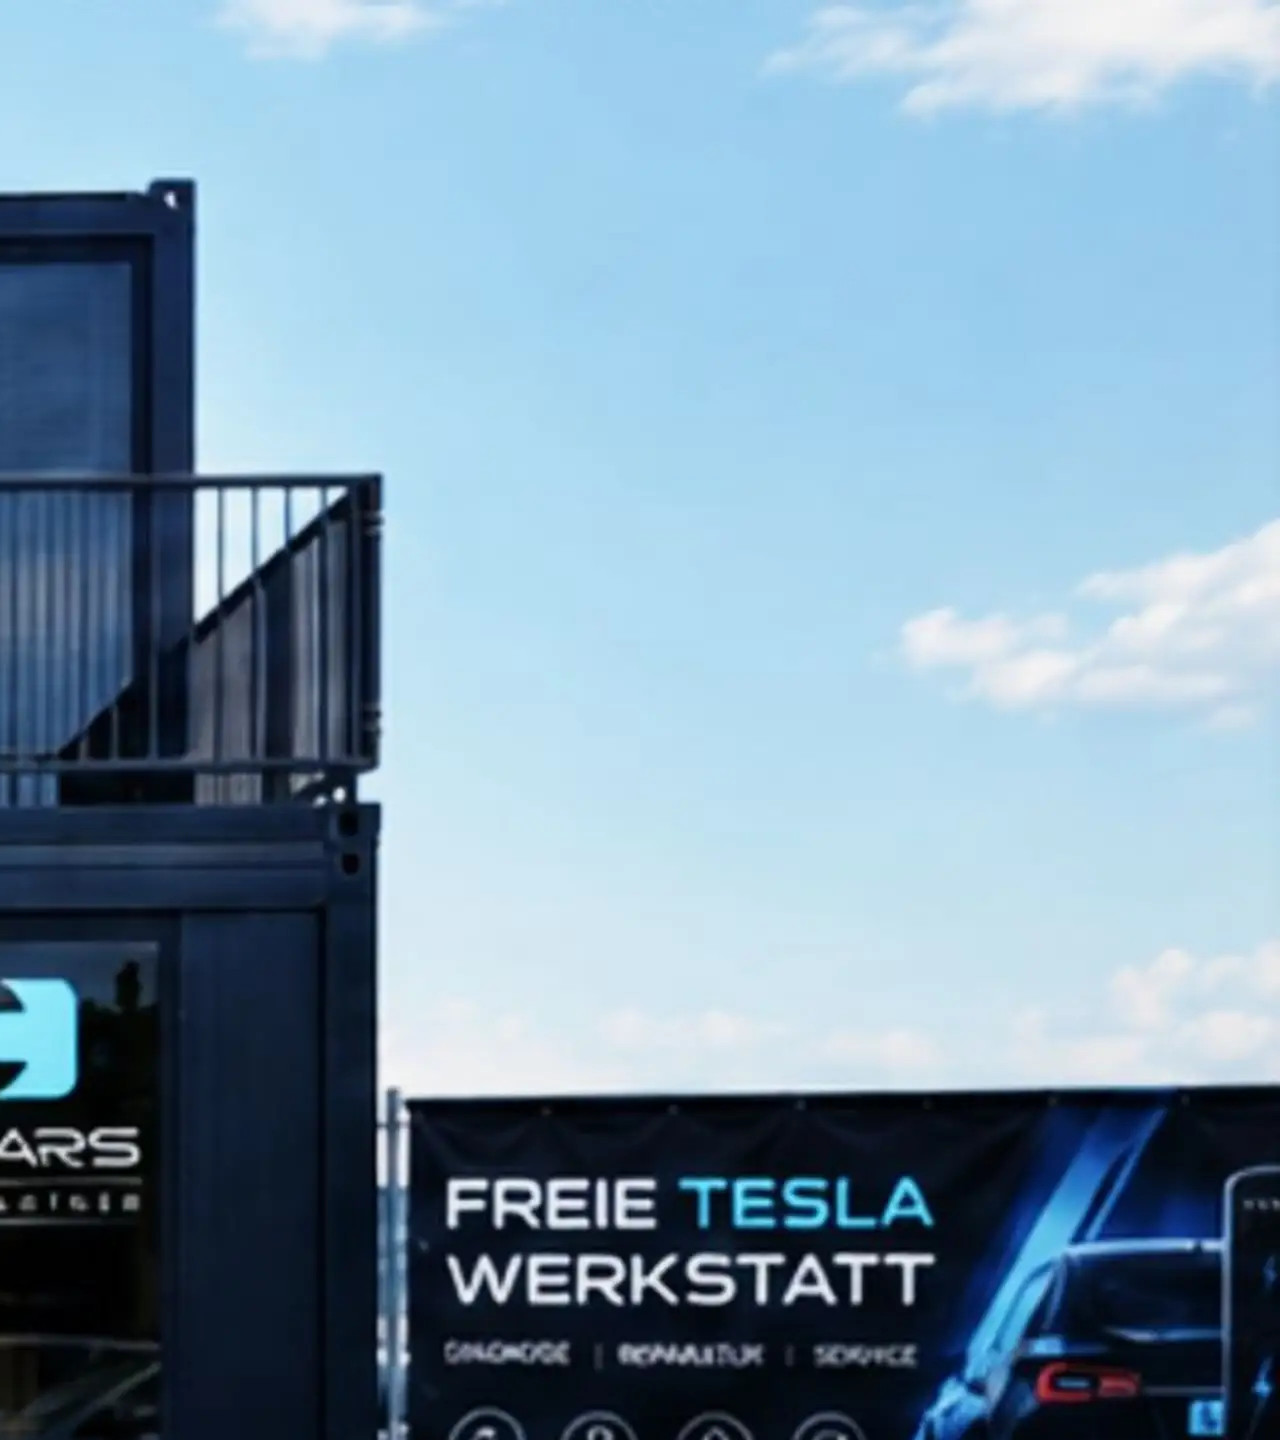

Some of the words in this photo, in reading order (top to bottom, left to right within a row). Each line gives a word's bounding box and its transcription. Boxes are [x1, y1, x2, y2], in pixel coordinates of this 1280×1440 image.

[446, 1178, 658, 1229] FREIE
[678, 1177, 935, 1228] TESLA
[445, 1254, 936, 1306] WERKSTATT
